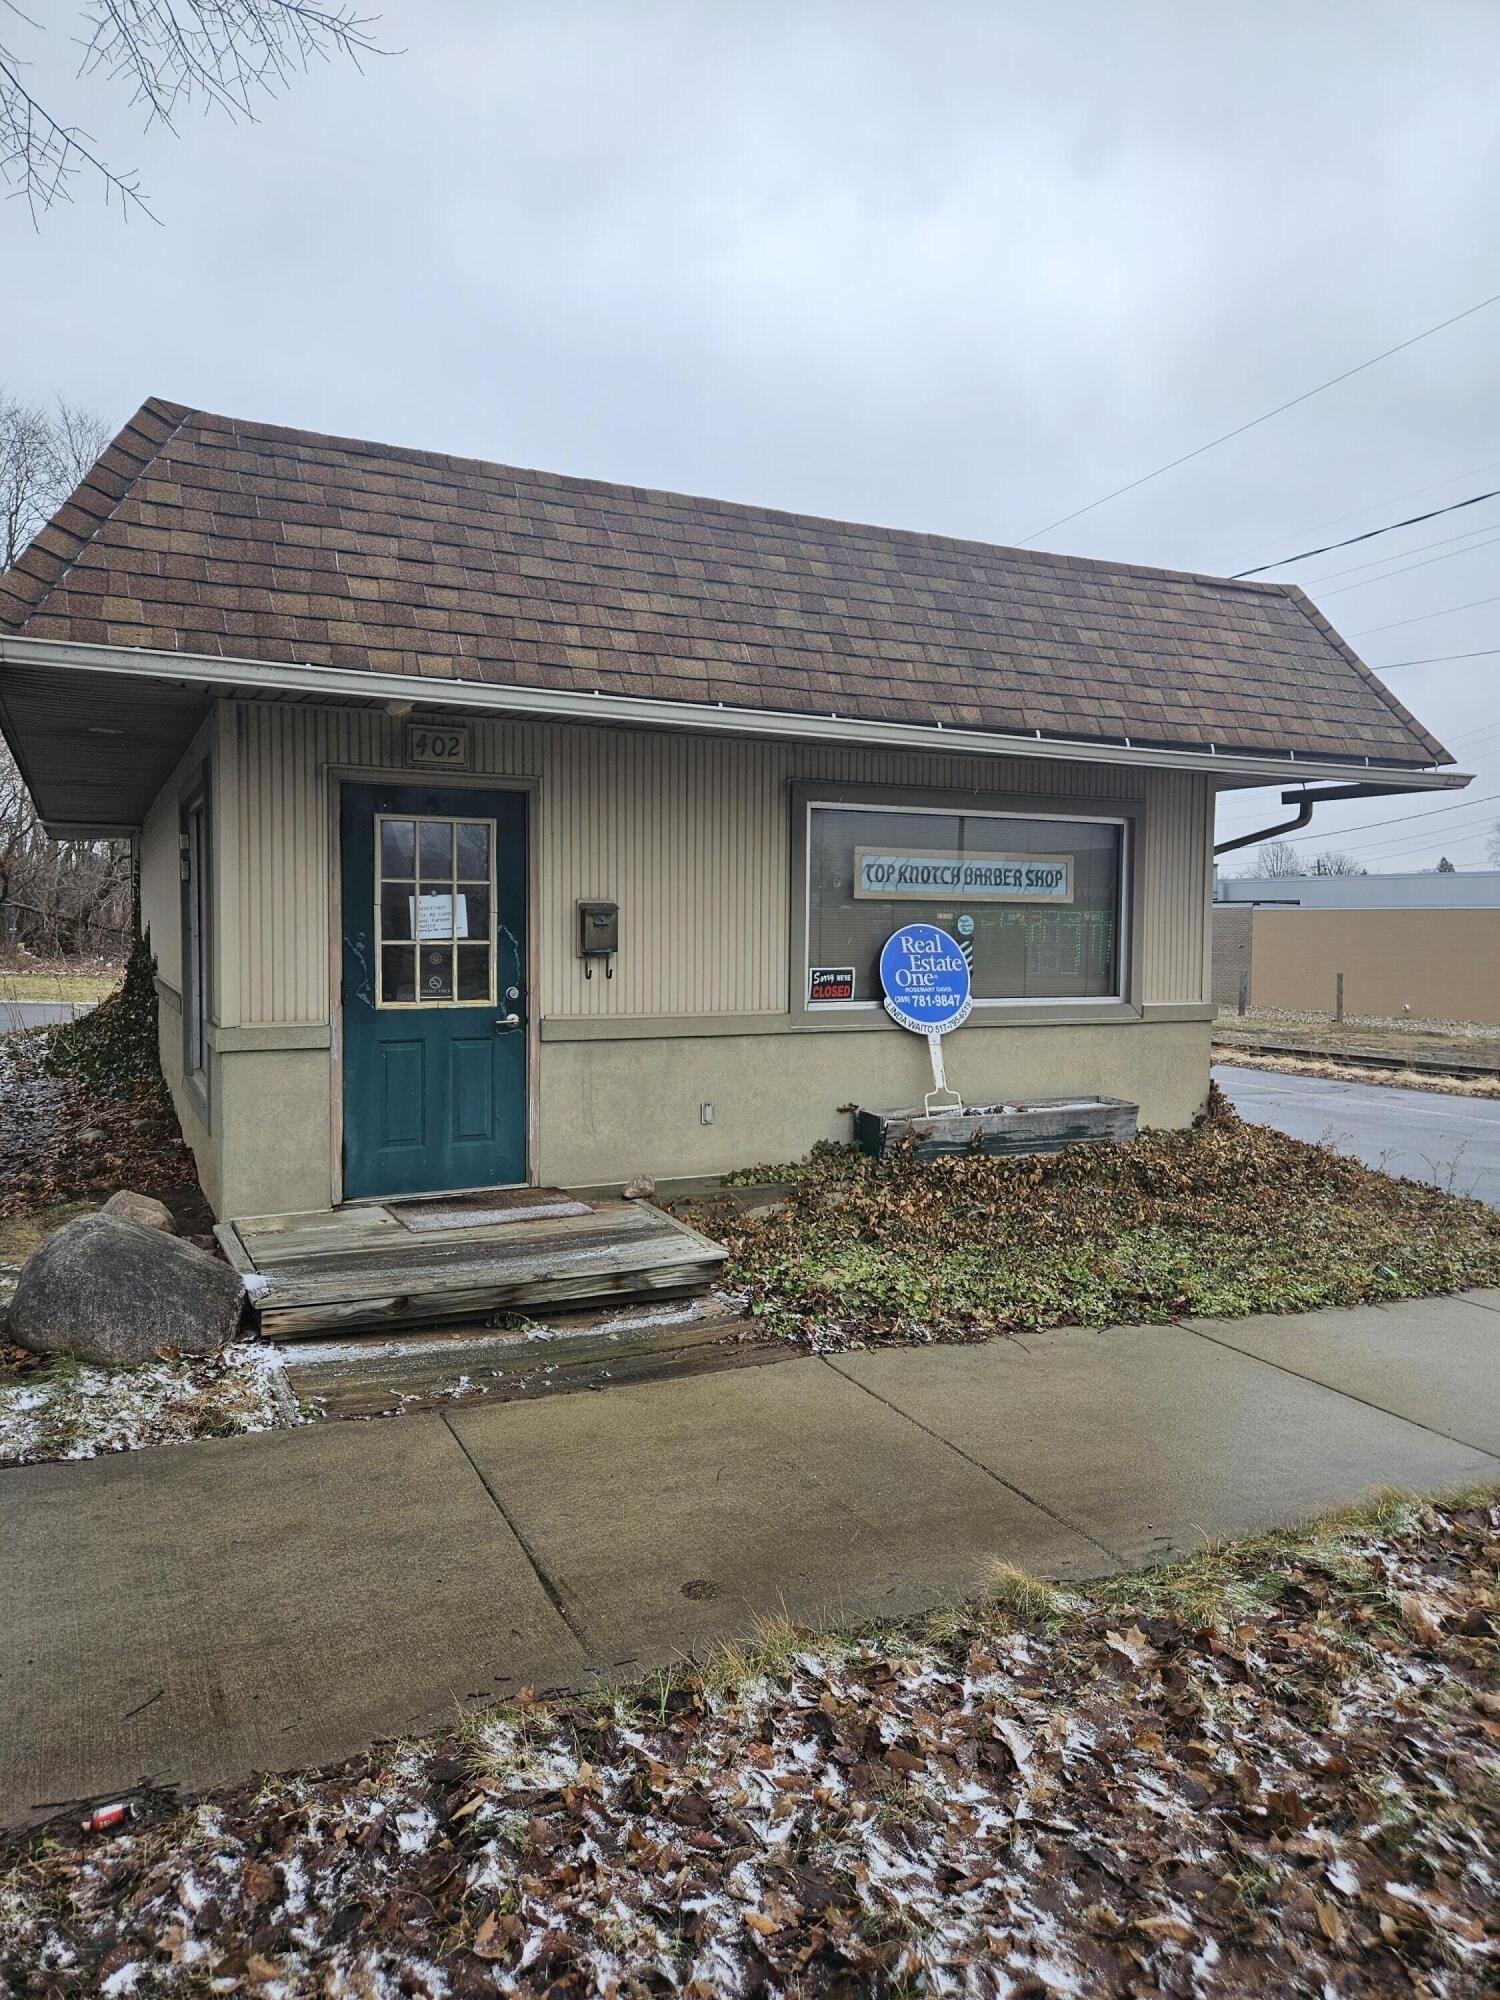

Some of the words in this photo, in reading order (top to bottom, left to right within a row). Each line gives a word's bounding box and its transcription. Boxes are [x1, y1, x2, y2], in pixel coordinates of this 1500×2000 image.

[416, 733, 460, 758] 402
[865, 863, 895, 884] TOP
[899, 864, 961, 885] KNOTCH
[963, 867, 1022, 888] BARBER
[1025, 869, 1063, 888] SHOP
[899, 934, 943, 953] Real
[908, 954, 962, 972] Estate
[813, 972, 835, 984] Sorry
[895, 969, 935, 986] One
[812, 985, 851, 998] CLOSED
[912, 994, 961, 1007] 781-9847
[886, 1003, 907, 1025] LINDA
[908, 1020, 934, 1034] WAITO
